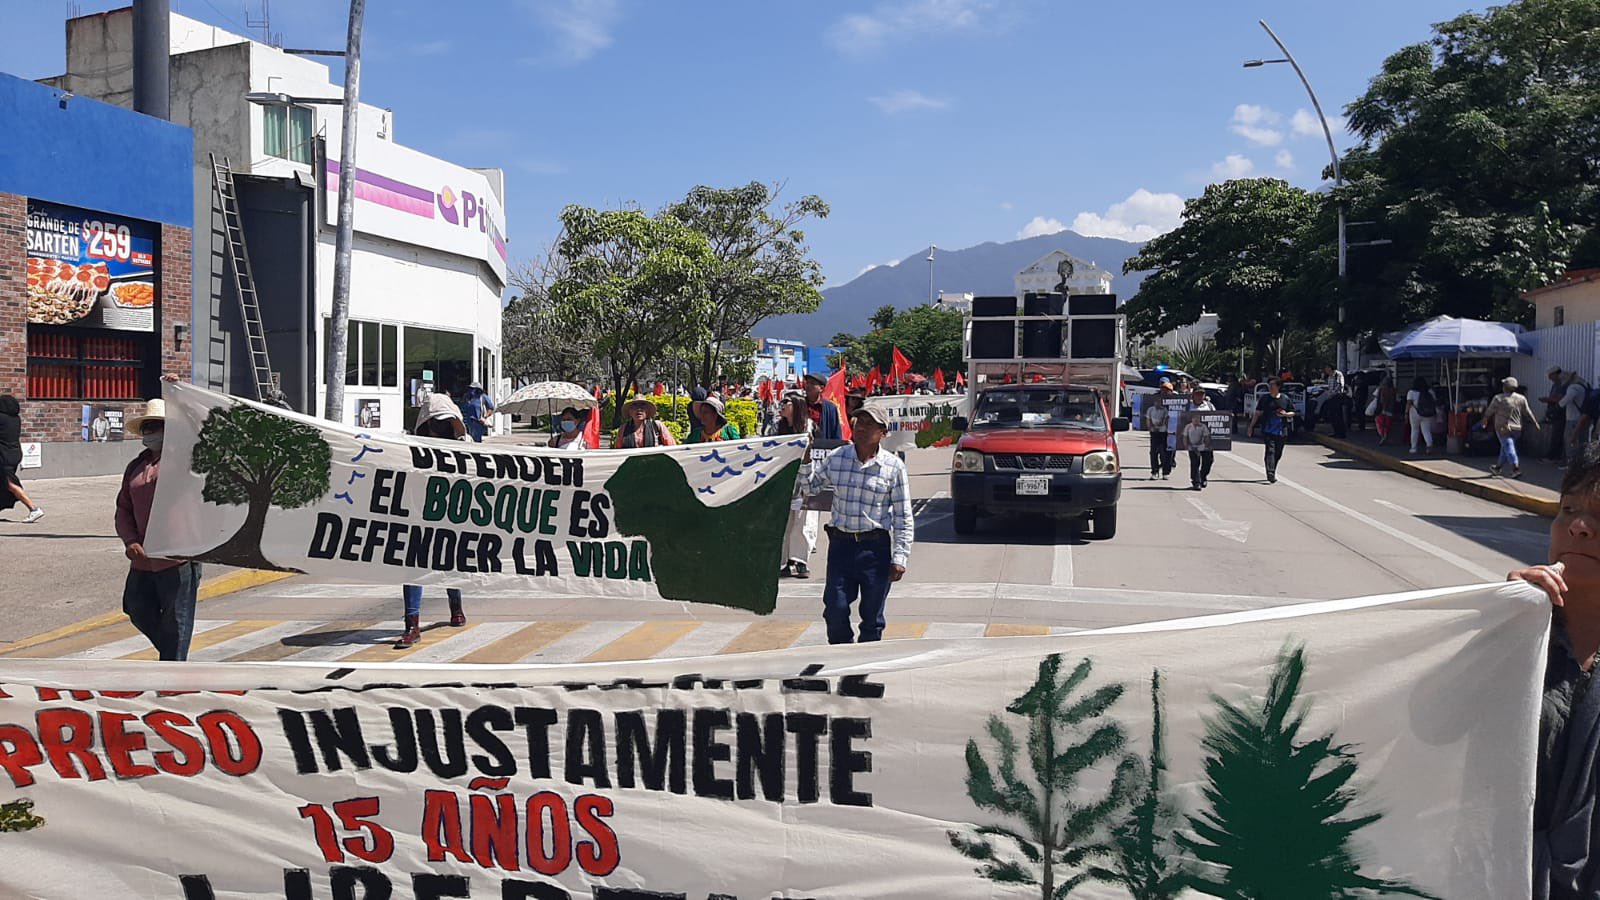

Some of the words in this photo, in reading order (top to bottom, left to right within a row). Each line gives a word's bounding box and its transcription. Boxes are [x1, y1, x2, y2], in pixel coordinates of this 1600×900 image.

[26, 229, 79, 257] SARTÉN
[27, 214, 66, 233] GRANDE
[68, 221, 80, 235] DE
[82, 219, 131, 259] $259
[898, 407, 908, 417] LA
[409, 446, 583, 487] DEFENDER
[370, 469, 409, 517] EL
[422, 476, 560, 535] BOSQUE
[569, 490, 610, 538] ES
[308, 512, 502, 573] DEFENDER
[512, 537, 558, 577] LA
[567, 540, 652, 582] VIDA
[0, 707, 263, 788] PRESO
[277, 704, 874, 808] INJUSTAMENTE
[300, 796, 395, 864] 15
[421, 777, 620, 877] AÑOS
